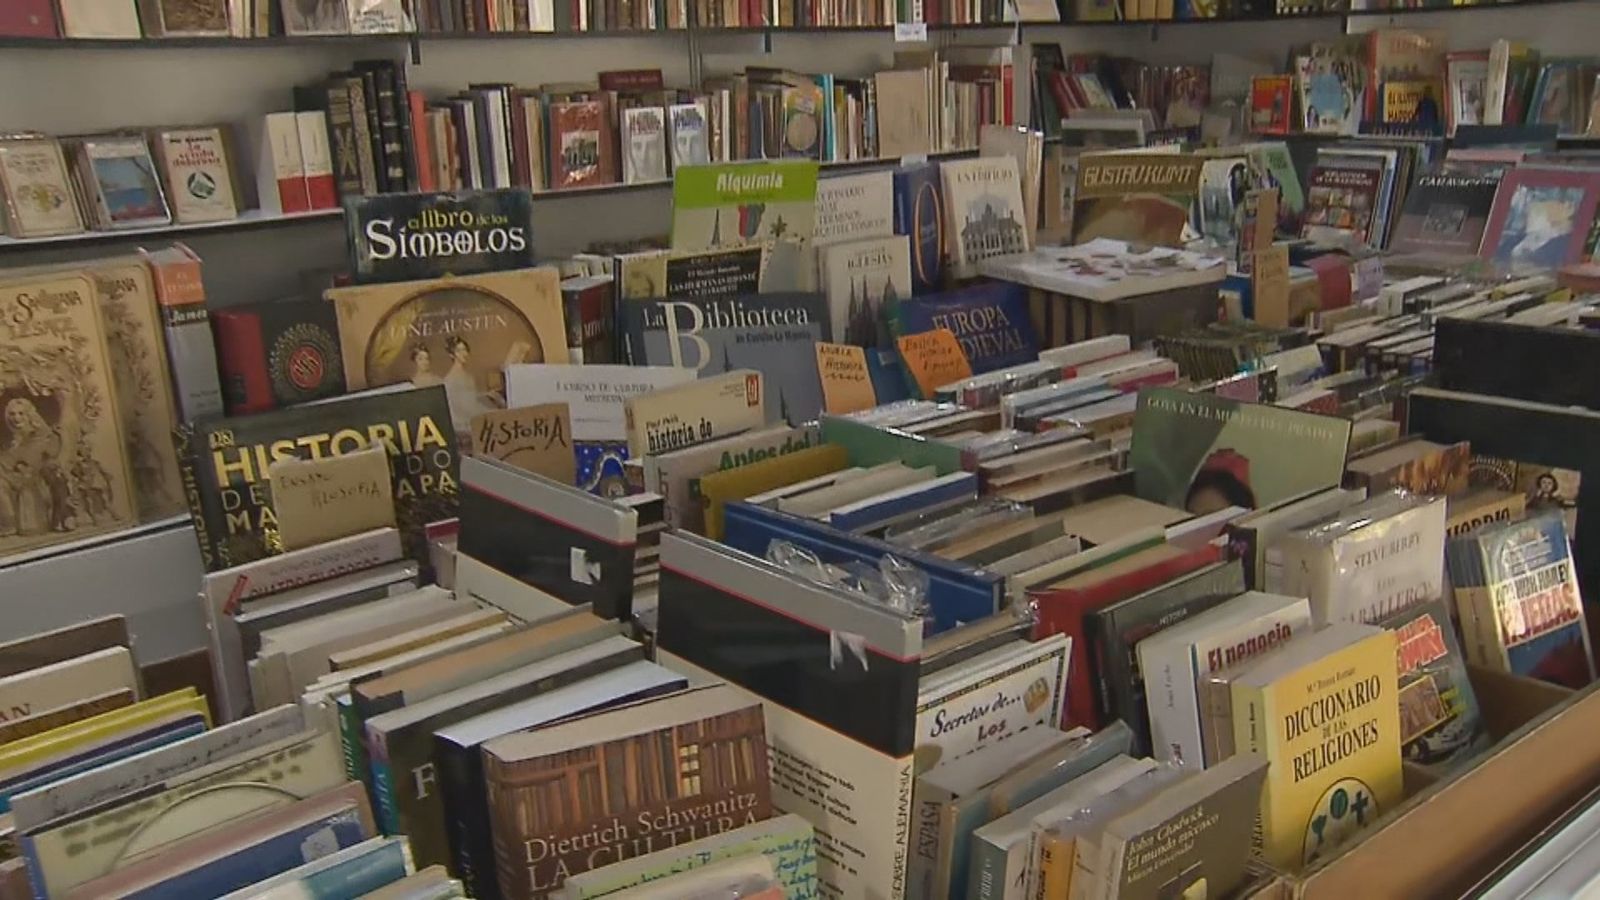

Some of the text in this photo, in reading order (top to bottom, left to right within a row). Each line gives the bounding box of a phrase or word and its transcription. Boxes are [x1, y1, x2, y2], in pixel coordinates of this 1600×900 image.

[716, 171, 784, 195] Alquimia
[1084, 163, 1193, 187] GUSTAV KLIMT
[421, 209, 473, 229] libro
[440, 315, 507, 334] AUSTEN
[932, 305, 1010, 336] EUROPA
[644, 308, 665, 328] La
[657, 300, 809, 373] Biblioteca
[961, 328, 1023, 361] DIEVAL
[647, 421, 697, 451] historia
[719, 446, 777, 471] Antes
[397, 470, 458, 500] APA
[225, 506, 280, 535] MA
[1207, 646, 1223, 672] El
[930, 705, 991, 738] Secretos
[1284, 674, 1381, 742] DICCIONARIO
[1292, 718, 1379, 784] RELIGIONES
[525, 791, 759, 864] Dietrich Schwanitz
[918, 800, 943, 861] ESPASA
[528, 811, 757, 893] LA CULTURA
[1141, 836, 1177, 865] mundo
